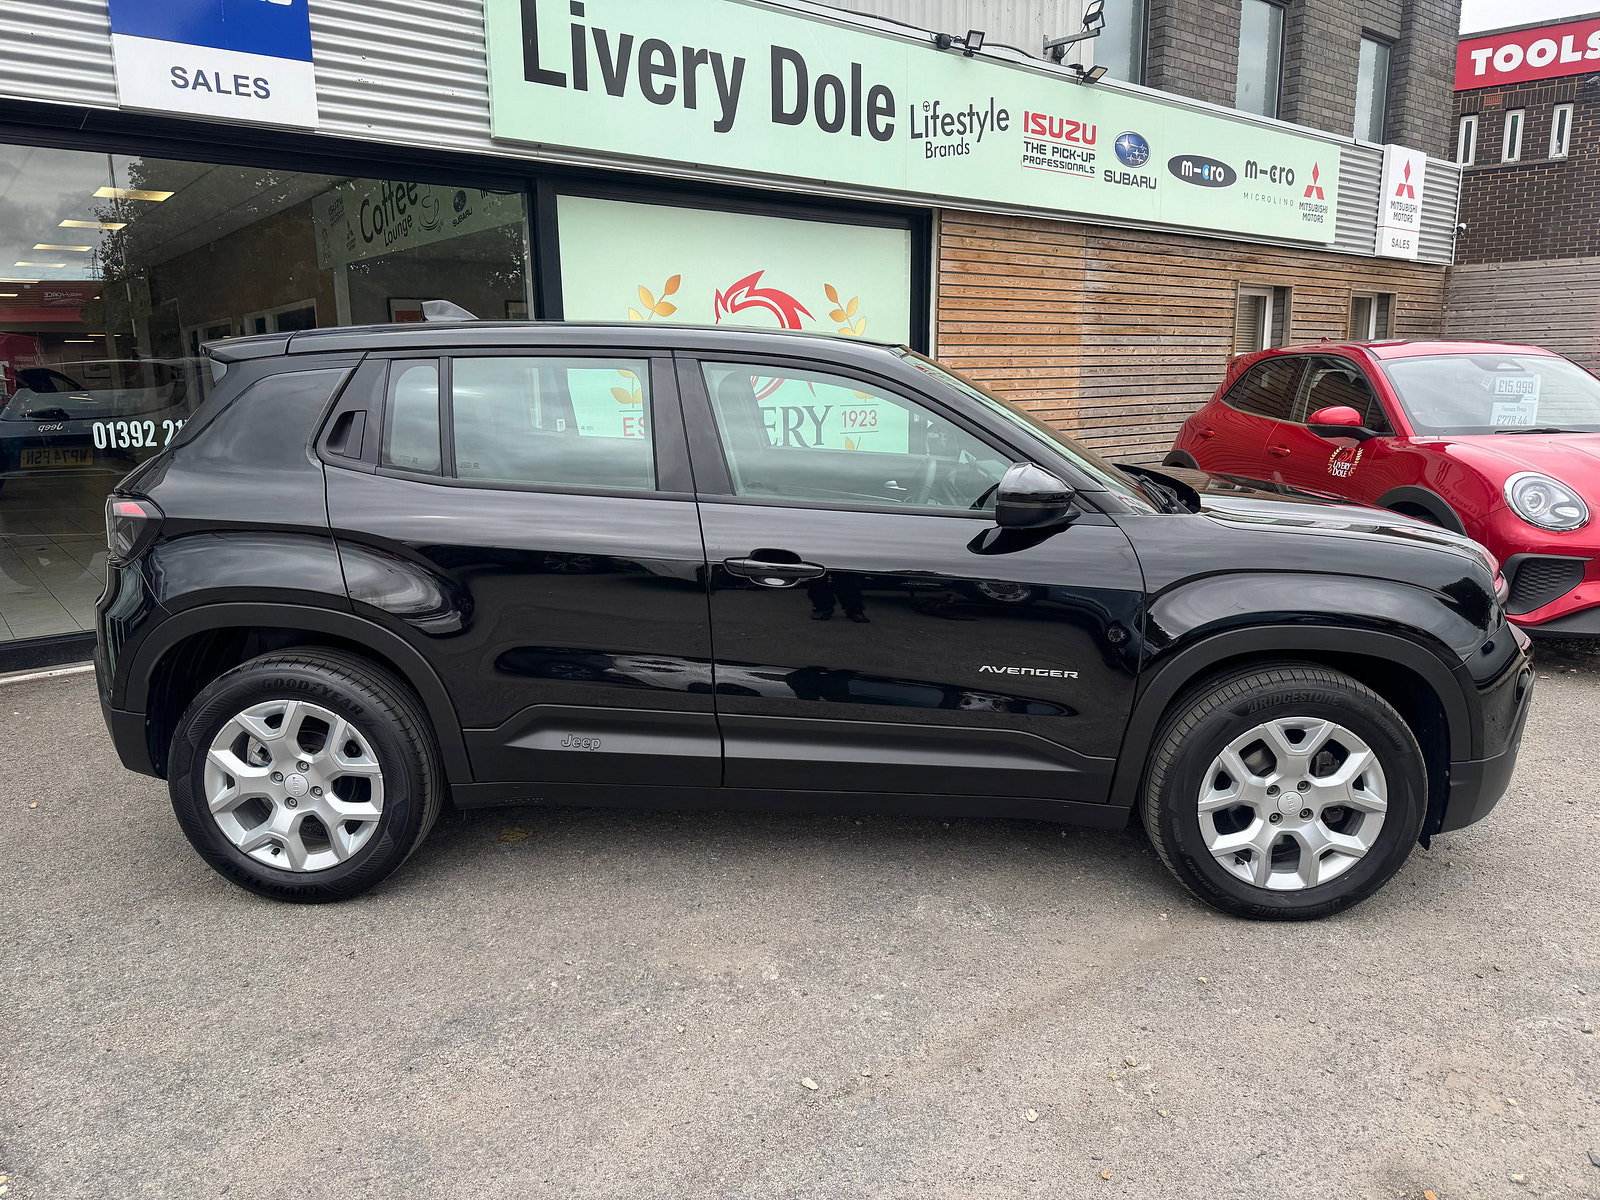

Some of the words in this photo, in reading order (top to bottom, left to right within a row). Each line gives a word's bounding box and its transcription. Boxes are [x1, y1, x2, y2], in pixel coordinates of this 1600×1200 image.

[520, 0, 746, 134] Livery
[770, 44, 896, 143] Dole
[170, 65, 271, 100] SALES
[910, 96, 1010, 143] Lifestyle
[1023, 110, 1097, 146] ISUZU
[925, 137, 971, 160] Brands
[1024, 141, 1047, 156] THE
[1052, 145, 1096, 164] PICK-UP
[1022, 154, 1096, 175] PROFESSIONALS
[1103, 169, 1157, 190] SUBARU
[1243, 191, 1294, 207] MICROLINO
[1298, 201, 1329, 215] MITSUBISHI
[1390, 200, 1418, 214] MITSUBISHI
[452, 207, 473, 228] SUBARU
[1302, 212, 1324, 224] MOTORS
[1392, 211, 1414, 224] MOTORS
[383, 213, 413, 247] Lounge
[1391, 237, 1410, 250] SALES
[1498, 379, 1534, 394] £15,999
[840, 409, 878, 428] 1923
[92, 420, 158, 450] 01392
[1331, 468, 1348, 478] DOLE
[1332, 460, 1352, 471] LIVERY
[977, 664, 1079, 680] AVENGER
[261, 677, 364, 715] GOODYEAR
[1248, 691, 1340, 714] BRIDGESTONE
[561, 732, 602, 752] Jeep
